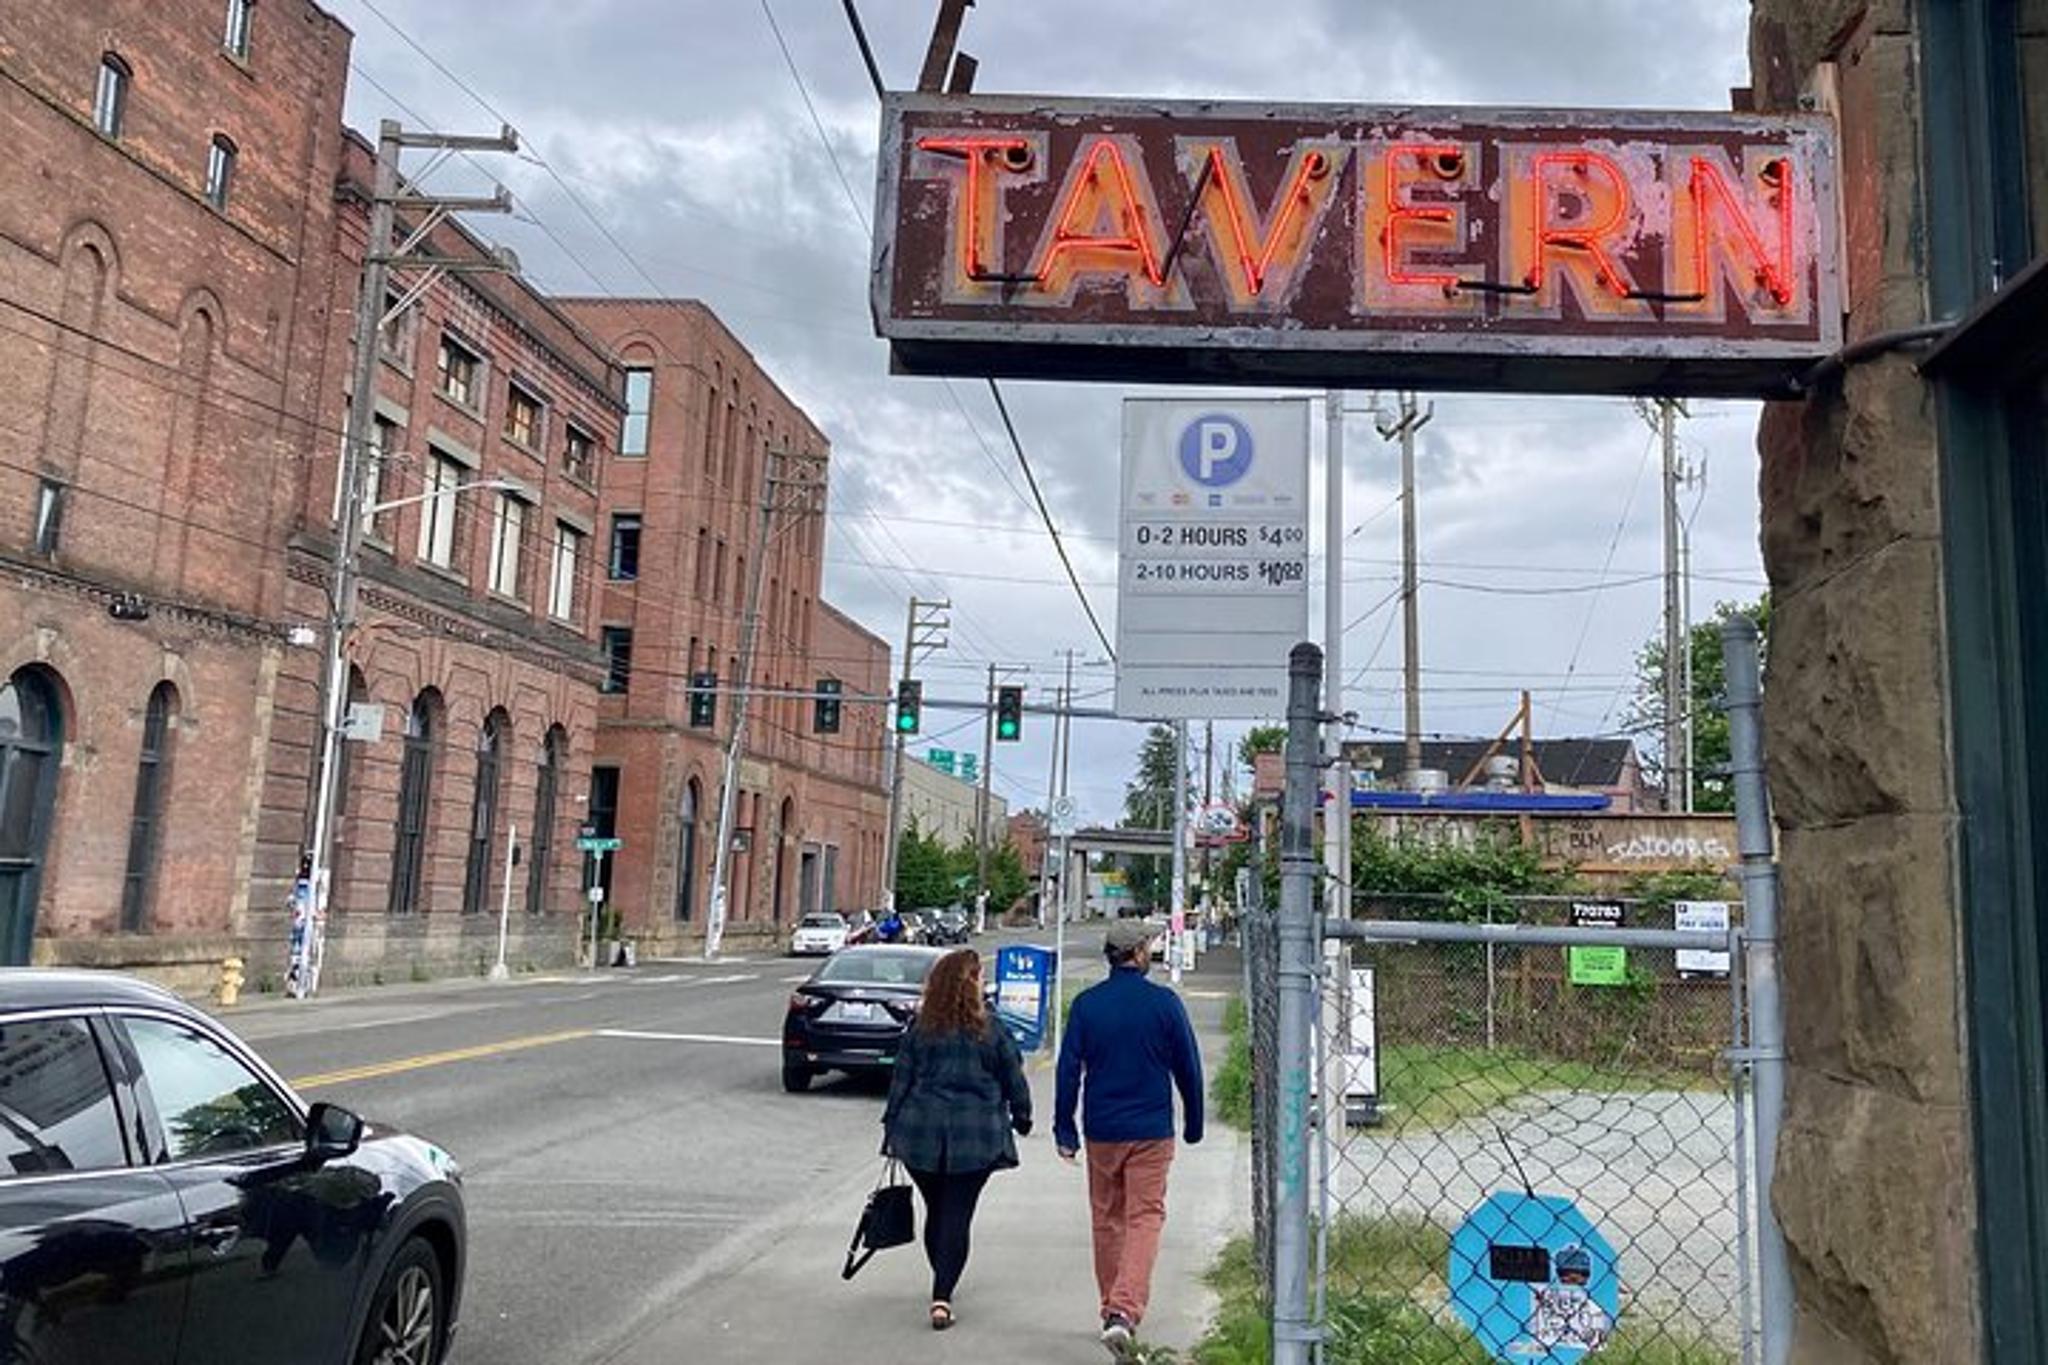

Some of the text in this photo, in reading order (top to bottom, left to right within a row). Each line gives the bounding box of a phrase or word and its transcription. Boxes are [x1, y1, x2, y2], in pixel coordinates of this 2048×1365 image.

[908, 129, 1811, 325] TAVERN
[1200, 422, 1238, 479] P
[1180, 526, 1248, 547] HOURS
[1136, 563, 1176, 581] 2-10
[1180, 563, 1250, 581] HOURS
